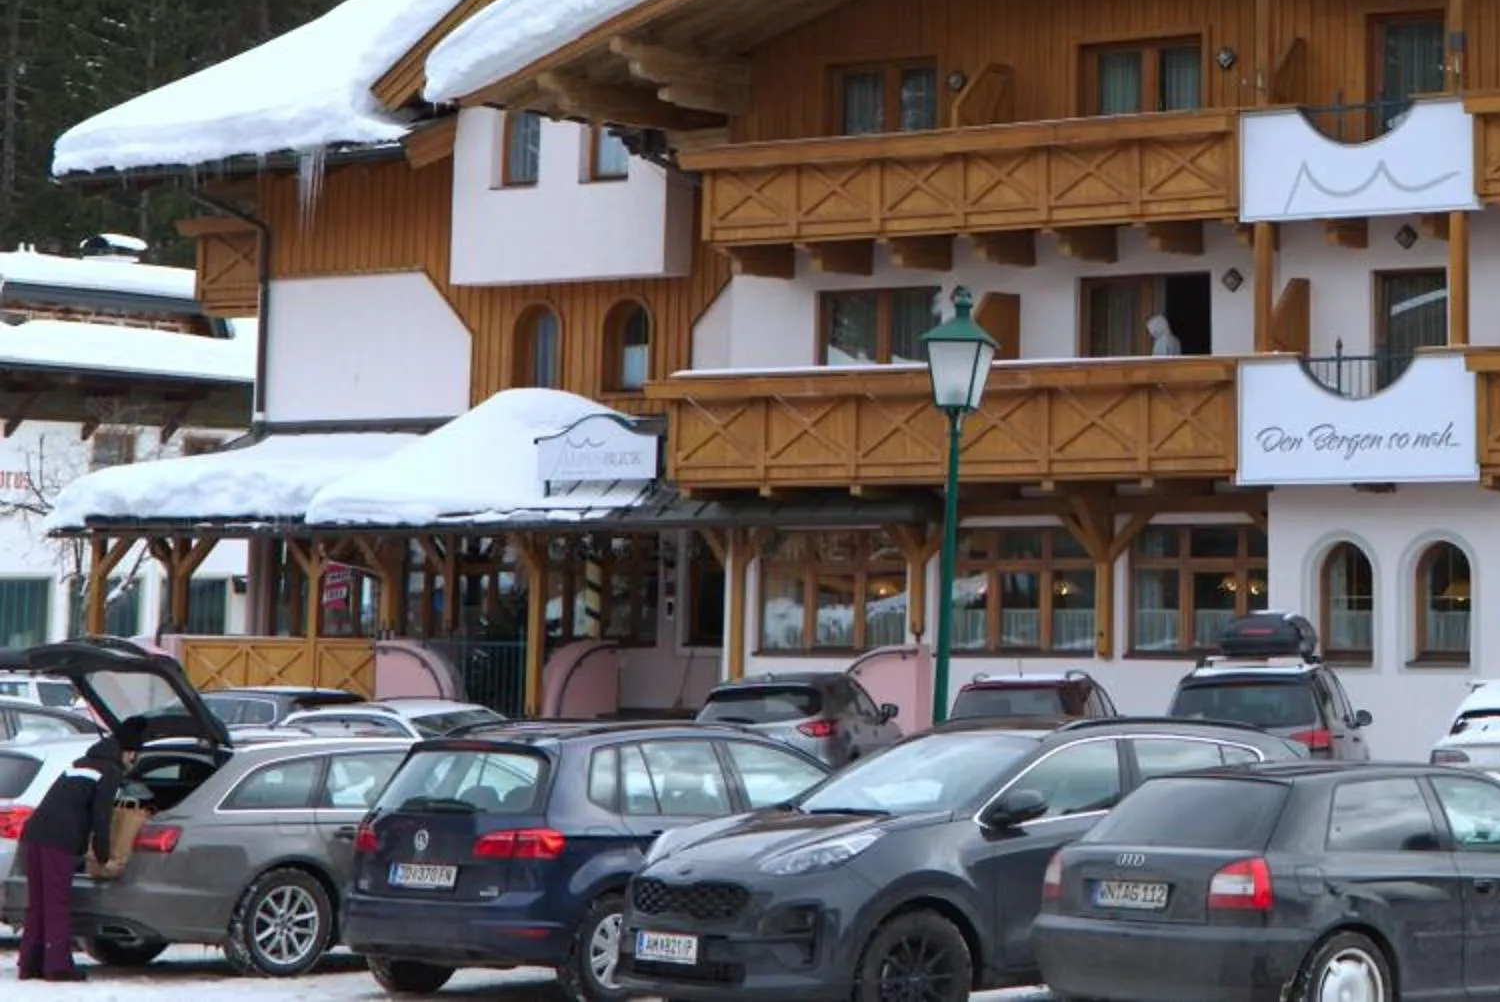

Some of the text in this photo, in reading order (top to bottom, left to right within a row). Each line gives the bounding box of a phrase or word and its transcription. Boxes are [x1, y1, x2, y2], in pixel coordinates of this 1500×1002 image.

[1256, 426, 1303, 453] Den
[1308, 423, 1383, 461] Bergen
[1387, 432, 1409, 449] so
